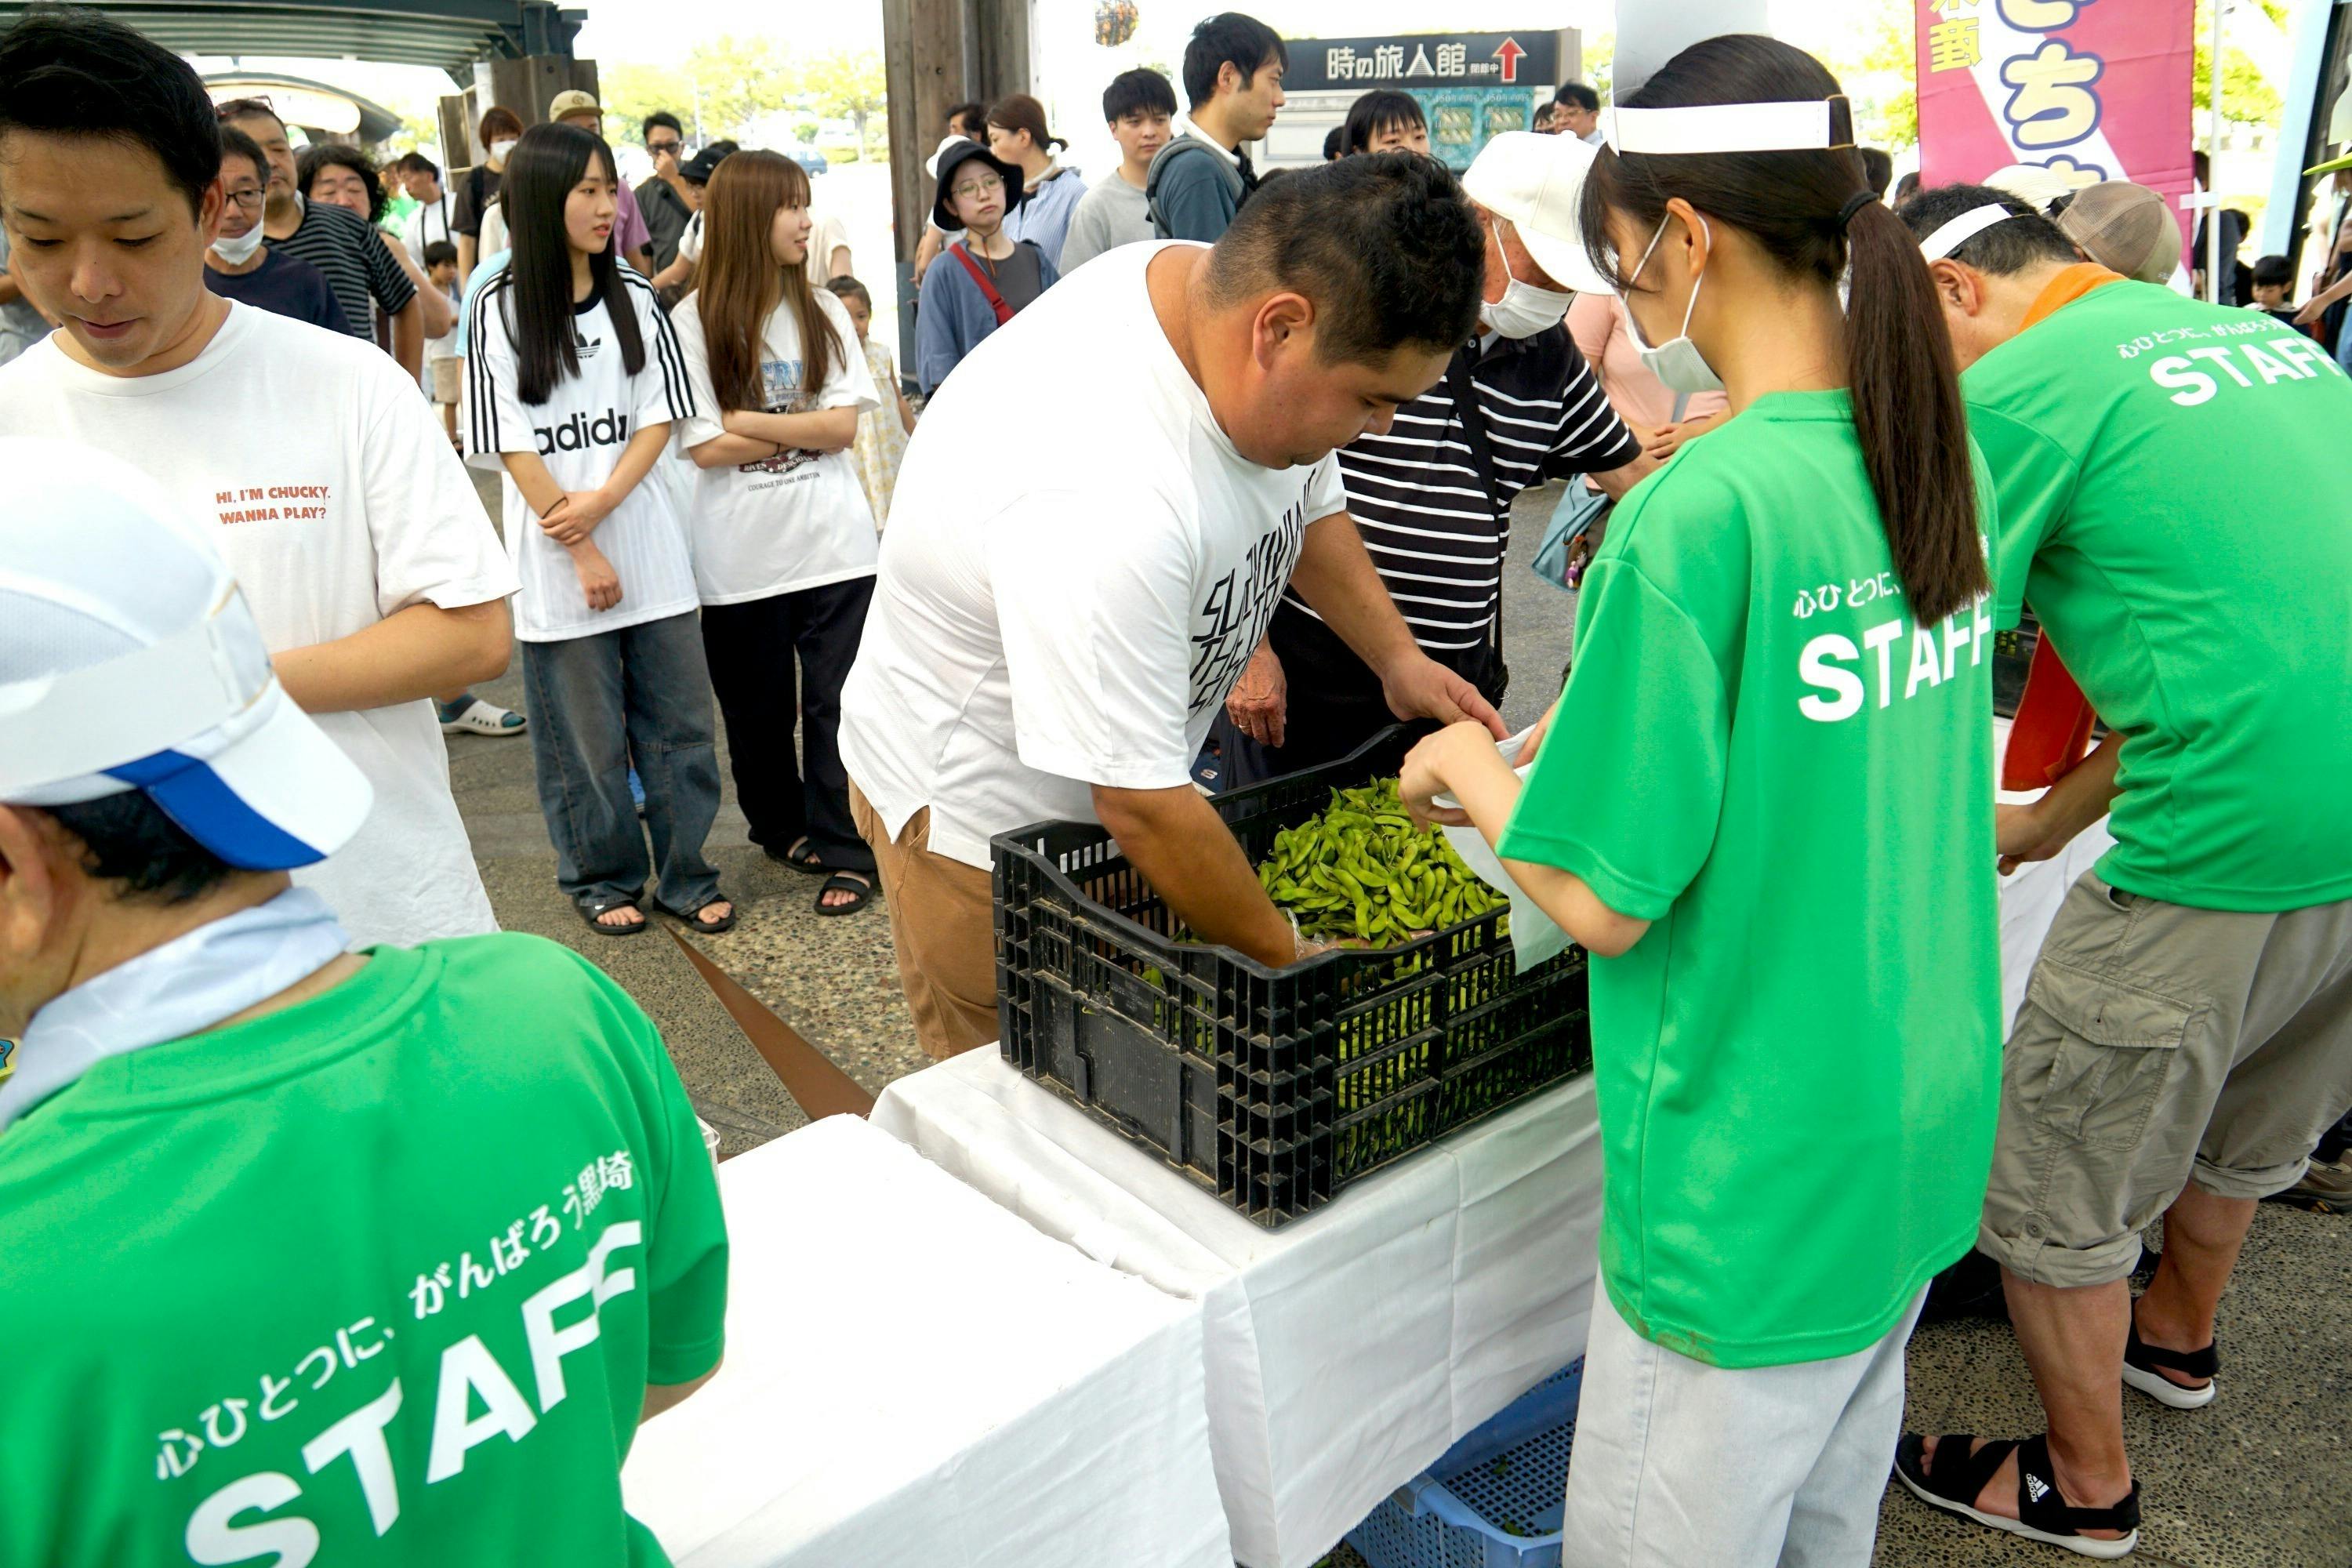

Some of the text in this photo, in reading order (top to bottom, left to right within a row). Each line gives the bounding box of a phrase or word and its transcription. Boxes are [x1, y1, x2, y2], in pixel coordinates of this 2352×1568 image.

[1327, 43, 1467, 79] 時の旅人館
[2150, 336, 2343, 406] STAFF
[239, 488, 264, 501] I'M
[219, 506, 326, 524] WANNA PLAY?
[1798, 587, 1991, 722] STAFF
[184, 1220, 641, 1568] STAFF
[2026, 1473, 2038, 1503] adidas
